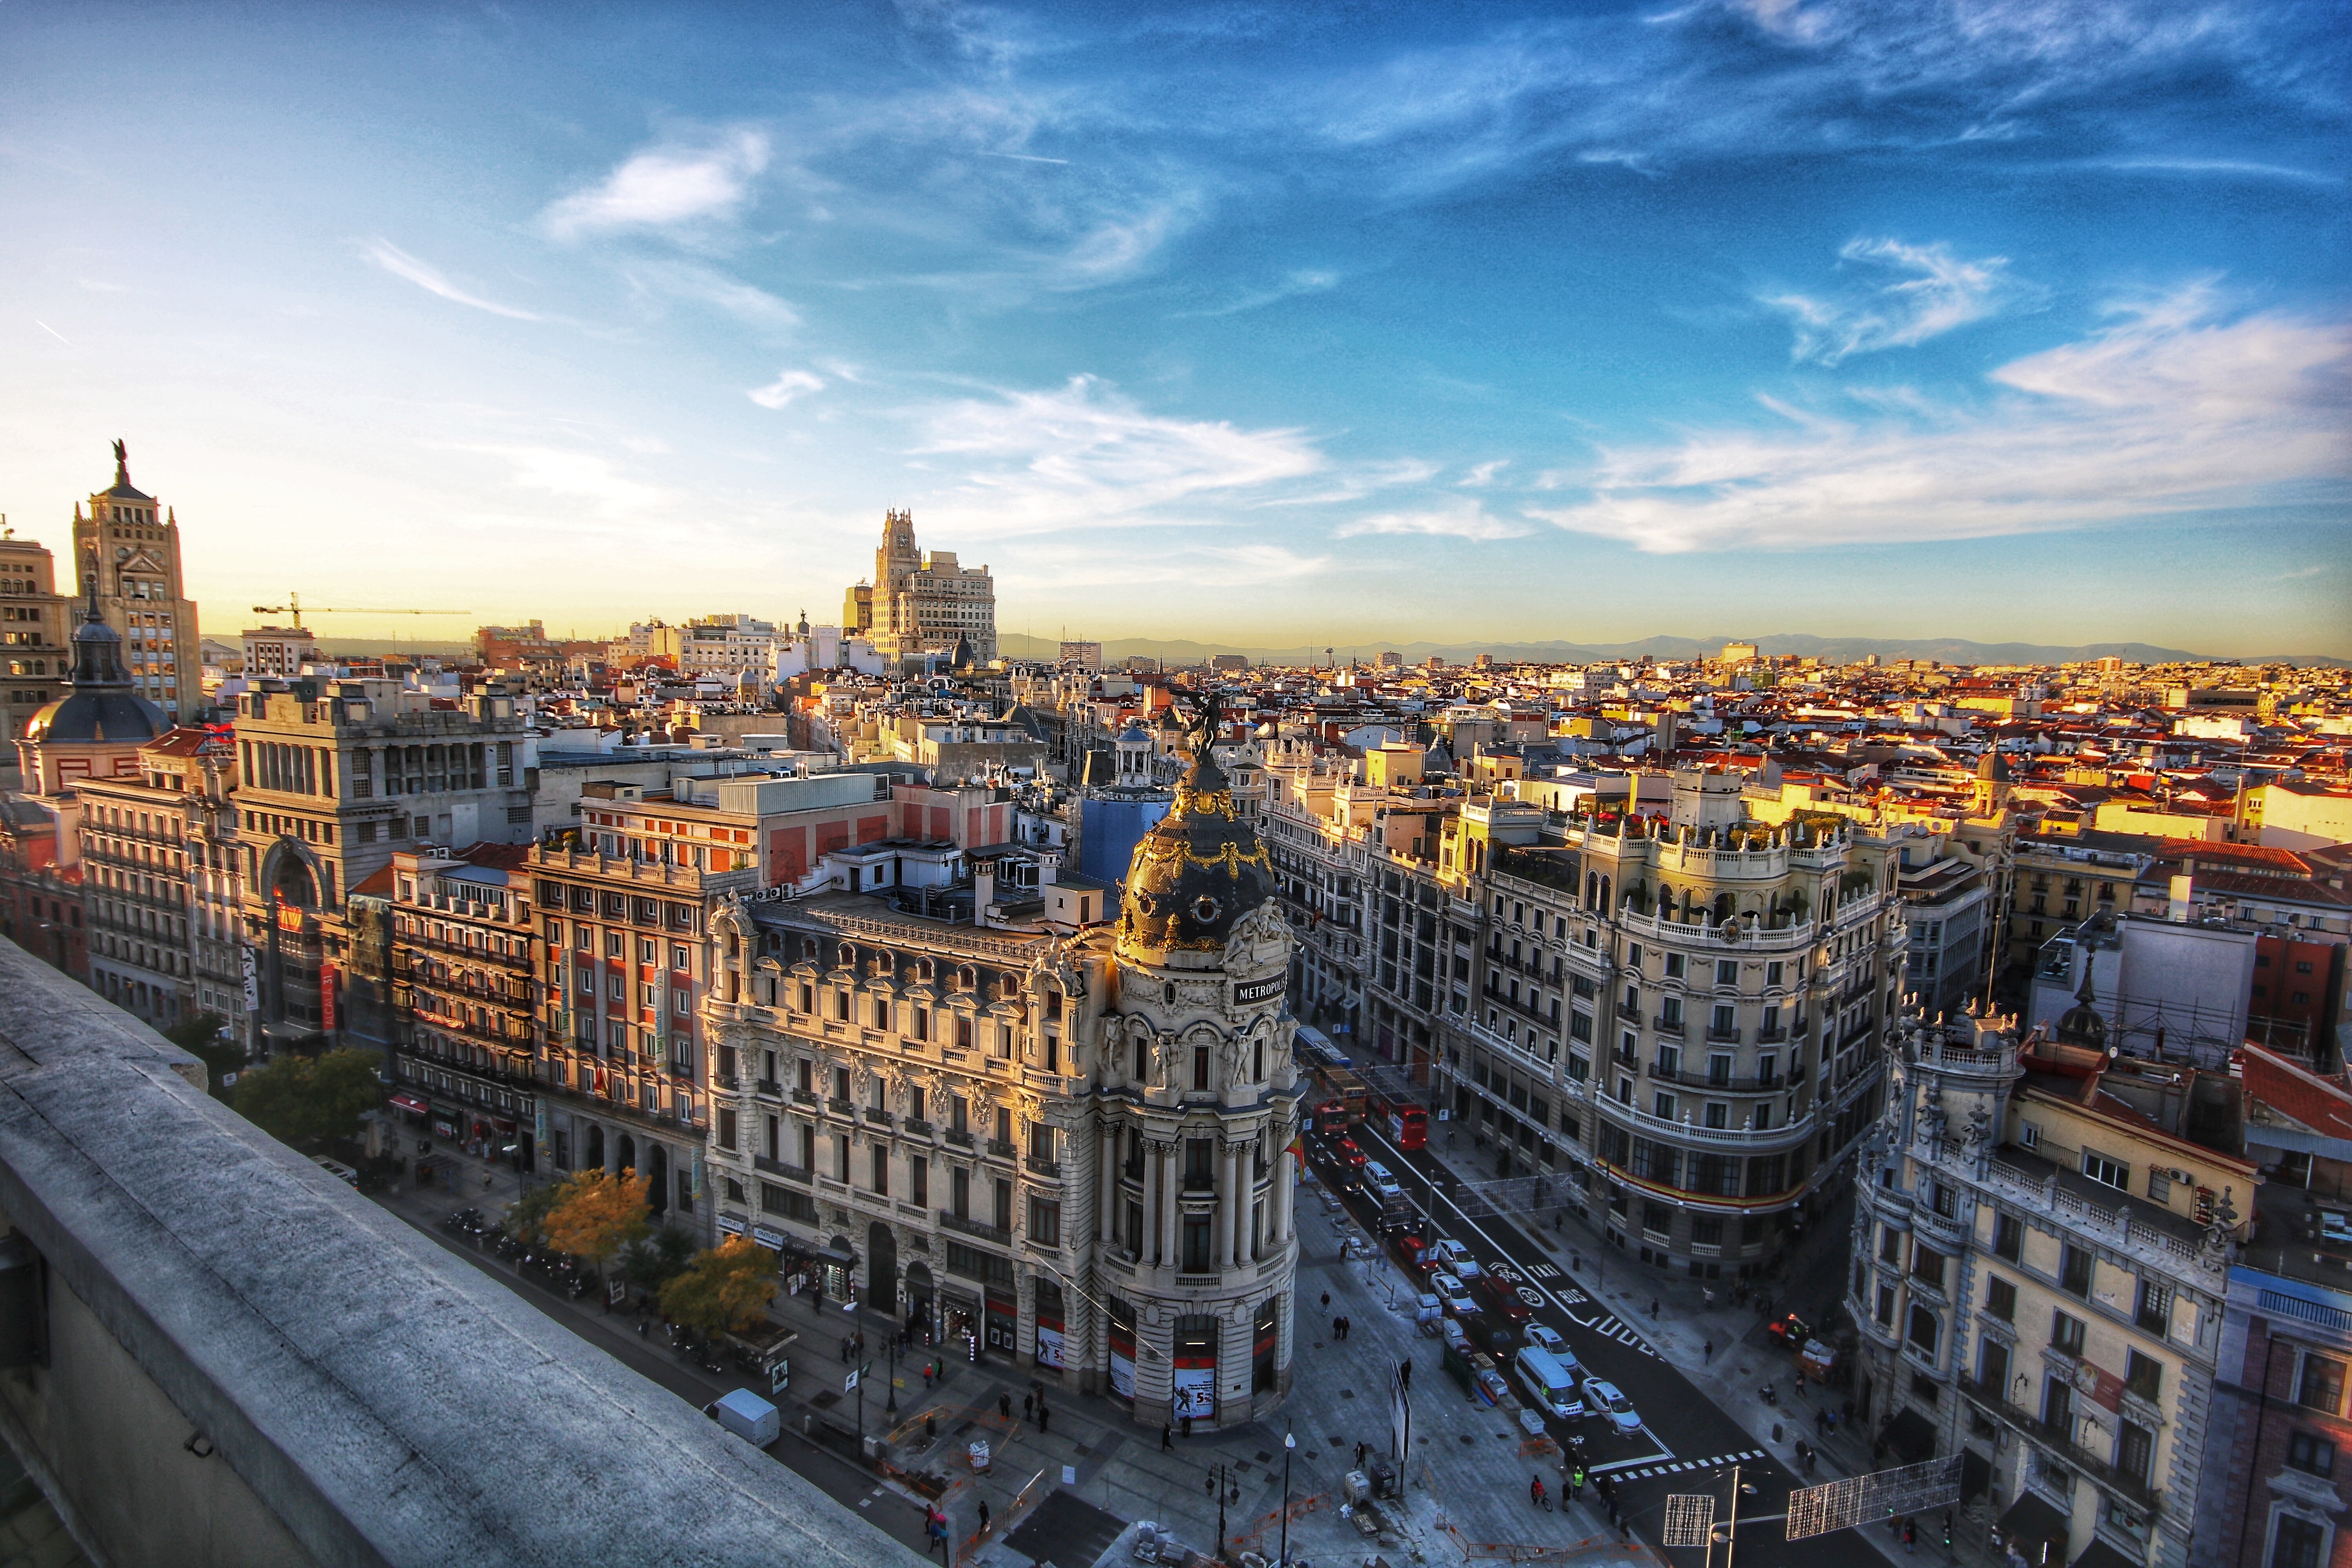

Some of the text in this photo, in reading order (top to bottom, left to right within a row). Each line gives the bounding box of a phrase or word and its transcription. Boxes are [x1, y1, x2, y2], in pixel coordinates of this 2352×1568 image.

[1240, 977, 1285, 1000] METROPOLIS
[322, 975, 334, 1025] ALCALÁ 31
[656, 1037, 664, 1054] hay
[722, 1218, 739, 1227] OUTLET
[758, 1230, 778, 1240] OUTLET
[1527, 1264, 1561, 1278] TAXI
[1522, 1292, 1538, 1301] 30
[1556, 1289, 1587, 1303] BUS
[1196, 1392, 1211, 1403] 5%
